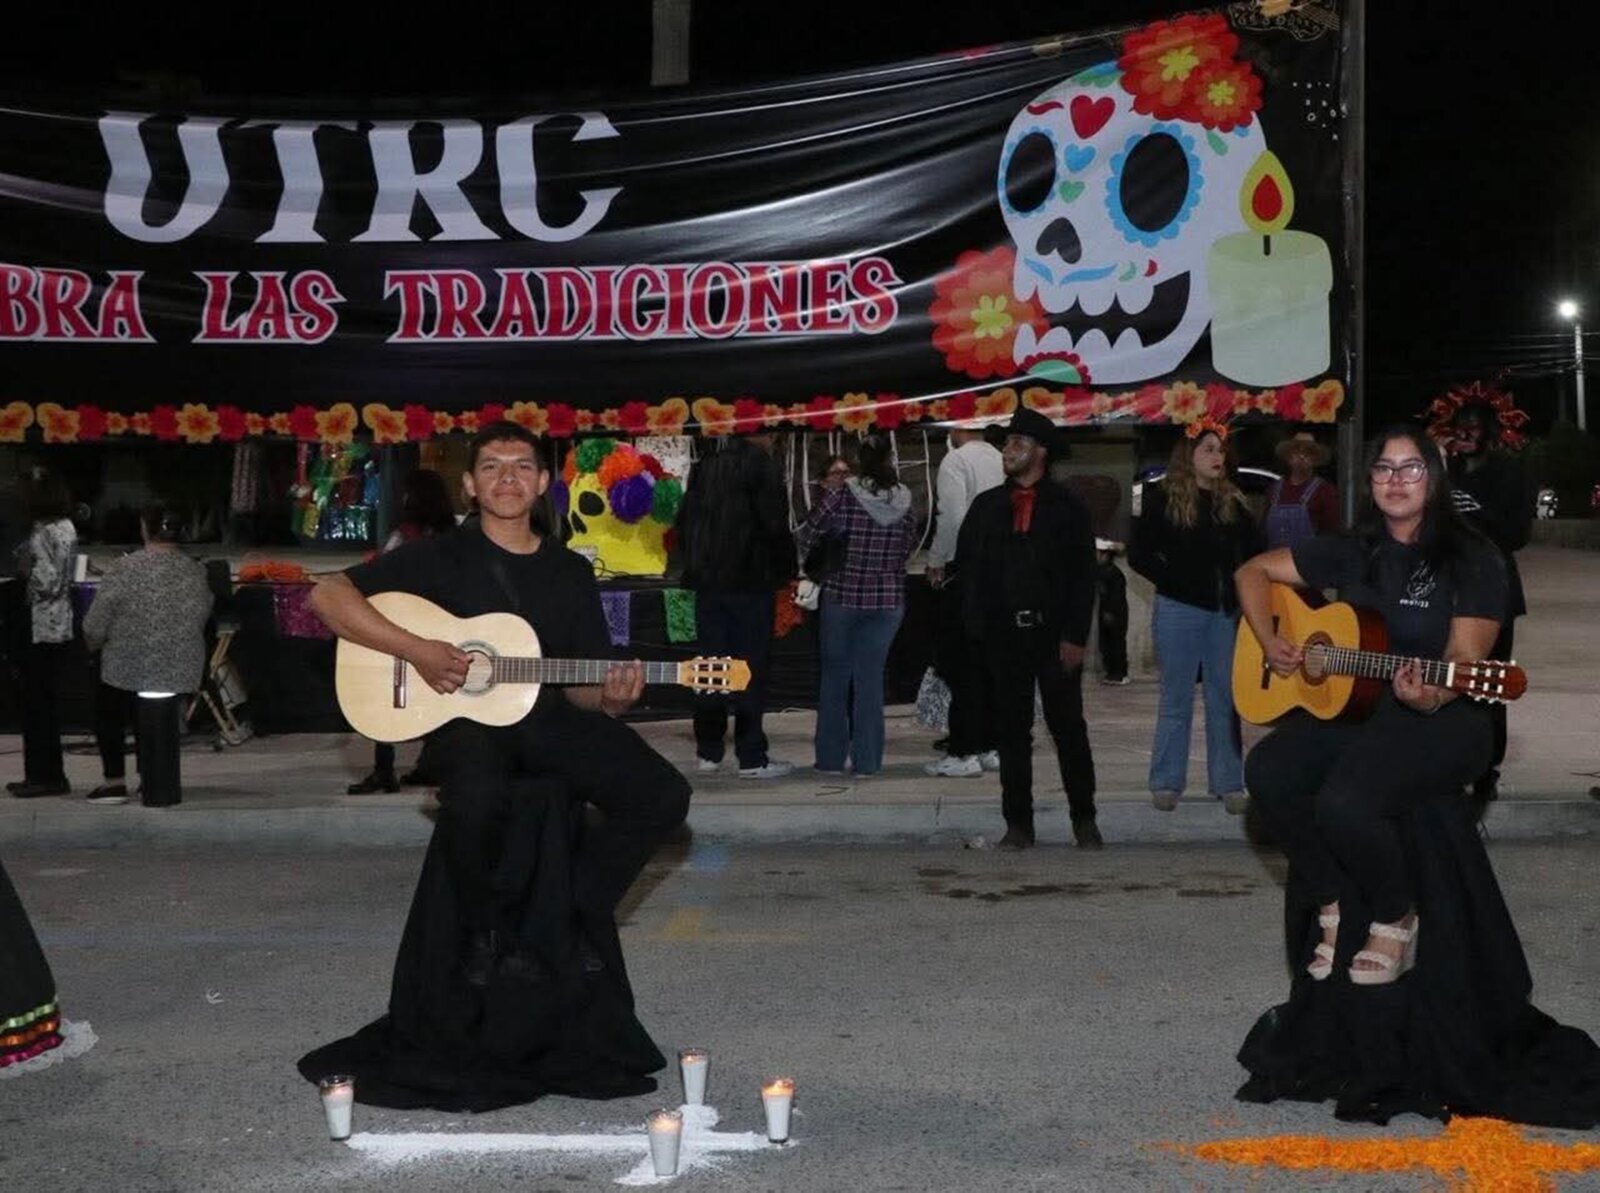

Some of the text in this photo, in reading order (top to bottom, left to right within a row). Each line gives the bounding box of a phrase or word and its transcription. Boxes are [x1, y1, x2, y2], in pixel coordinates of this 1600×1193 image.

[99, 112, 624, 243] UTRC
[0, 256, 904, 344] BRA LAS TRADICIONES
